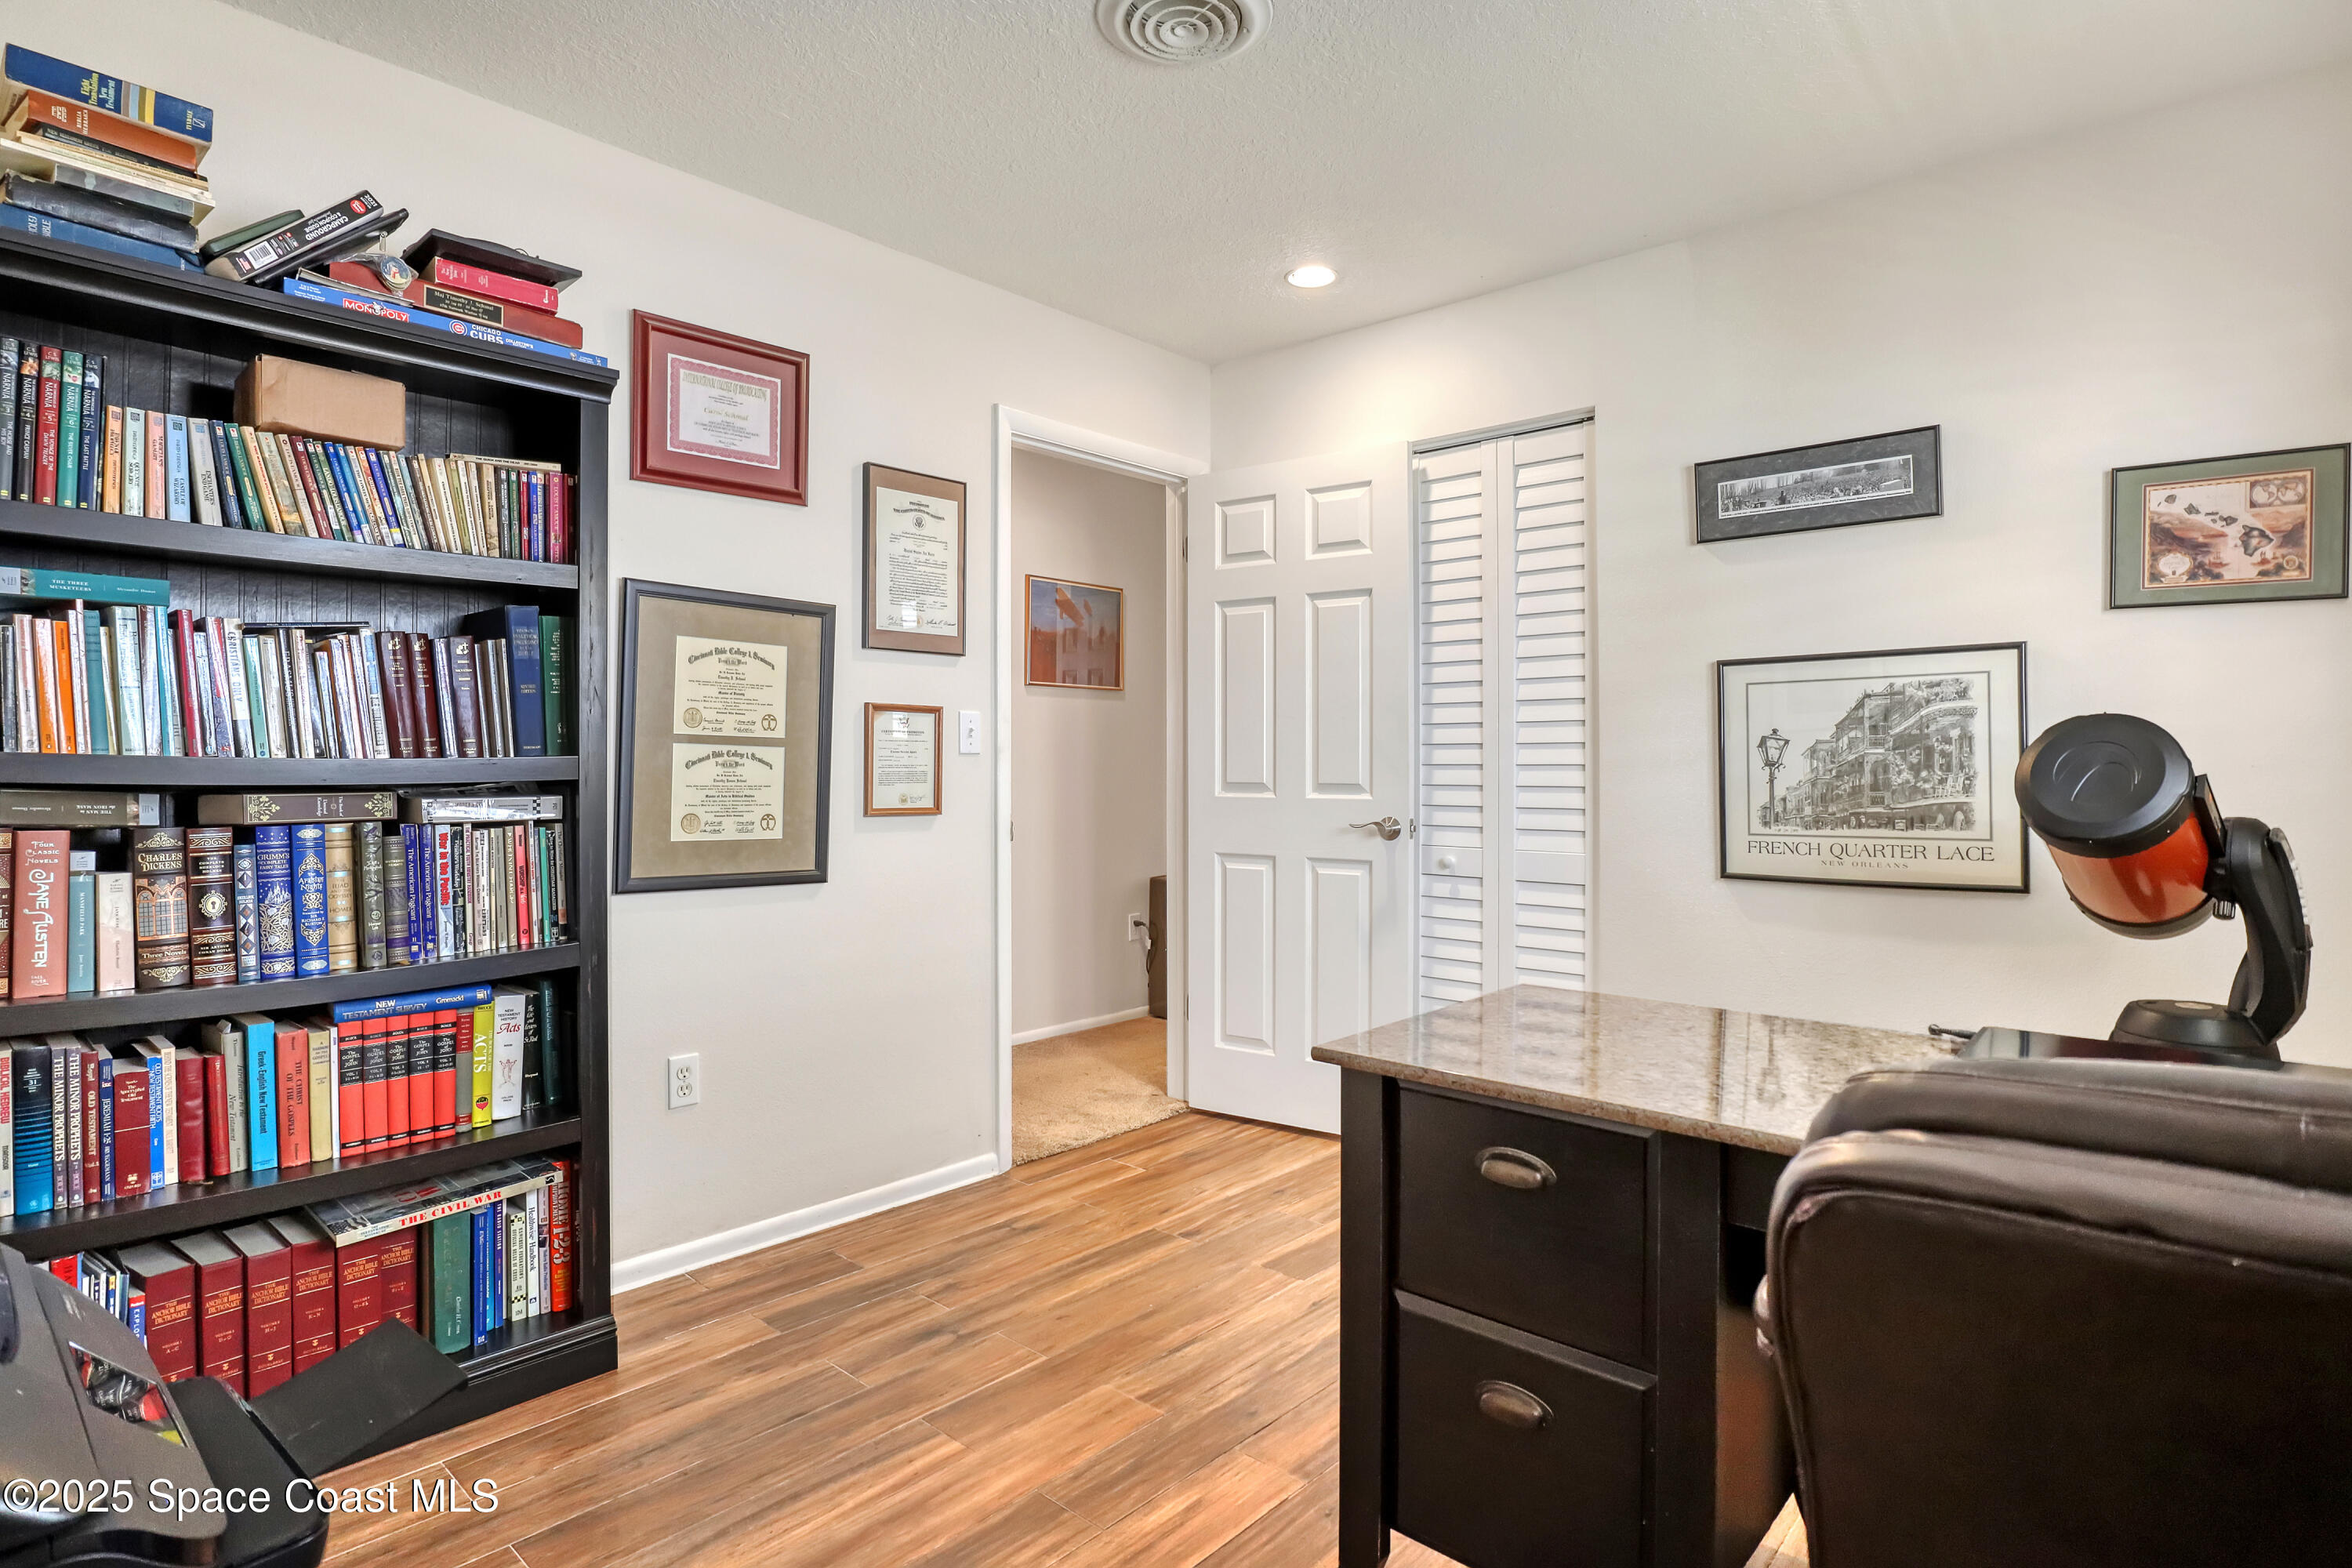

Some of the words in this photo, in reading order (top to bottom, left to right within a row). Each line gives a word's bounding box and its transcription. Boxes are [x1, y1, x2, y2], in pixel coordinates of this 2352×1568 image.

[304, 222, 321, 233] GUIDE
[306, 216, 349, 241] CAMPGROUND
[343, 299, 408, 322] MONOPOLY
[470, 331, 503, 344] CUBS
[472, 325, 501, 336] CHICAGO
[22, 378, 32, 404] NARNIA
[44, 382, 53, 408] NARNIA
[66, 386, 75, 412] NARNIA
[82, 389, 91, 415] NARNIA
[227, 631, 241, 678] CHRISTIANS
[729, 647, 747, 657] College
[753, 651, 775, 670] Seminary
[726, 750, 745, 759] College
[751, 753, 773, 770] Seminary
[439, 833, 448, 849] War
[1748, 840, 1821, 856] FRENCH
[1830, 843, 1927, 860] QUARTER
[1937, 846, 1995, 862] LACE
[138, 853, 183, 863] CHARLES
[439, 851, 448, 861] in
[140, 862, 182, 872] DICKENS
[440, 862, 449, 875] the
[28, 869, 54, 909] JANE
[441, 877, 450, 906] Pacific
[24, 909, 54, 967] AUSTEN
[343, 1006, 394, 1019] TESTAMENT
[395, 1003, 426, 1013] SURVEY
[496, 1022, 521, 1035] Acts
[474, 1033, 487, 1073] ACTS
[54, 1058, 64, 1079] THE
[70, 1054, 78, 1075] THE
[257, 1051, 266, 1091] Greek-English
[55, 1081, 64, 1113] MINOR
[71, 1078, 80, 1112] MINOR
[55, 1115, 65, 1162] PROPHETS
[71, 1113, 81, 1161] PROPHETS
[88, 1109, 96, 1156] TESTAMENT
[399, 1213, 427, 1227] THE
[431, 1200, 470, 1218] CIVIL
[474, 1191, 502, 1205] WAR
[552, 1225, 571, 1265] 1-2-3
[381, 1250, 401, 1261] ANCHOR
[383, 1255, 412, 1265] DICTIONARY
[343, 1265, 364, 1275] ANCHOR
[365, 1261, 378, 1269] BIBLE
[347, 1269, 376, 1280] DICTIONARY
[296, 1275, 318, 1287] ANCHOR
[318, 1271, 332, 1280] BIBLE
[299, 1279, 329, 1291] DICTIONARY
[205, 1295, 228, 1308] ANCHOR
[229, 1292, 242, 1301] BIBLE
[251, 1287, 273, 1298] ANCHOR
[253, 1291, 286, 1305] DICTIONARY
[151, 1306, 176, 1319] ANCHOR
[176, 1301, 191, 1311] BIBLE
[154, 1311, 189, 1324] DICTIONARY
[208, 1301, 241, 1314] DICTIONARY
